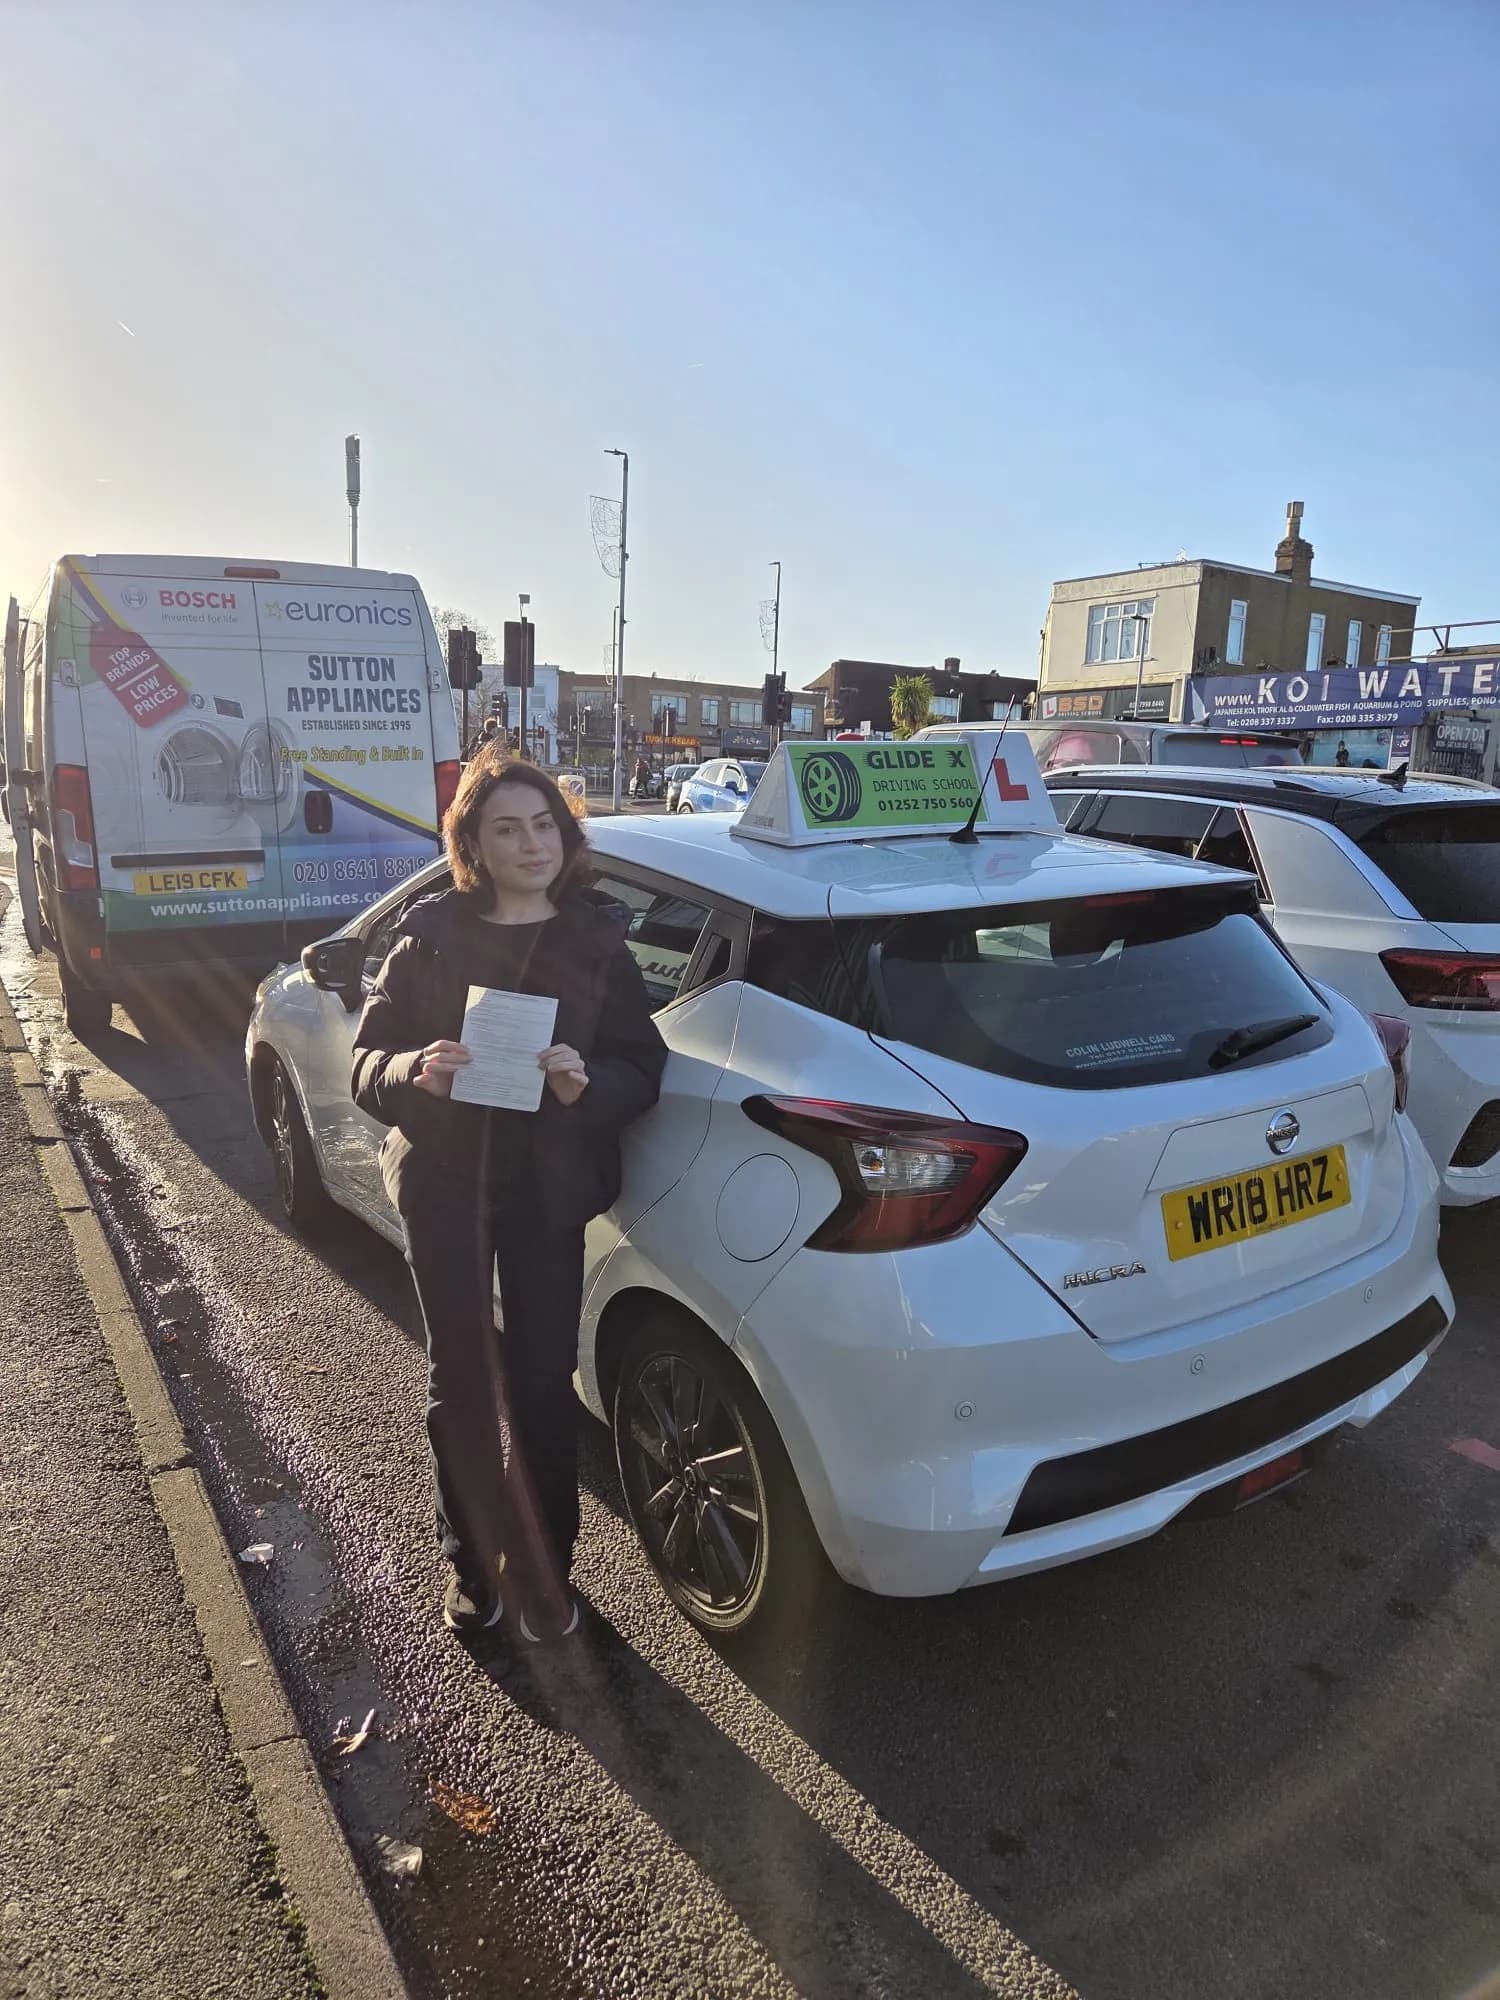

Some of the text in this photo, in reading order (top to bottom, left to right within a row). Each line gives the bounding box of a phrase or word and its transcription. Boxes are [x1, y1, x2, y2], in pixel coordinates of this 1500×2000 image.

[159, 590, 236, 609] BOSCH
[285, 600, 412, 626] euronics
[105, 650, 150, 682] BRANDS
[108, 647, 130, 665] TOP
[308, 654, 396, 682] SUTTON
[130, 675, 160, 700] LOW
[1257, 674, 1330, 705] KOI
[1358, 663, 1500, 699] WATE
[133, 684, 178, 716] PRICES
[286, 687, 421, 714] APPLIANCES
[1058, 695, 1104, 712] BSD
[1214, 707, 1244, 716] JAPANESE
[1257, 705, 1287, 714] TROPICAL
[1294, 703, 1334, 712] COLDWATER
[1334, 702, 1351, 711] FISH
[1353, 700, 1393, 710] AQUARIUM
[1393, 701, 1399, 709] &
[1400, 699, 1422, 709] POND
[1427, 696, 1469, 707] SUPPLIES,
[1471, 696, 1497, 705] POND
[302, 719, 411, 731] ESTABLISHED SINCE 1995
[1226, 713, 1399, 727] Tel: 0208 337 3337 Fax: 0208 335 3979
[1437, 725, 1485, 743] OPEN 7 DA
[280, 746, 307, 762] Free
[311, 745, 366, 765] Standing
[369, 746, 379, 761] &
[381, 746, 410, 761] Built
[866, 750, 966, 770] GLIDE X
[873, 778, 977, 792] DRIVING SCHOOL
[993, 758, 1030, 802] L
[879, 797, 974, 812] 01252 750 560
[149, 871, 237, 892] LE19 CFK
[293, 861, 329, 883] 020
[334, 858, 378, 881] 8641
[1065, 1043, 1100, 1058] COLIN
[1100, 1037, 1149, 1052] LUDWELL
[1148, 1033, 1176, 1045] CARS
[1188, 1155, 1333, 1244] WR18 HRZ
[1063, 1261, 1147, 1289] MICRA
